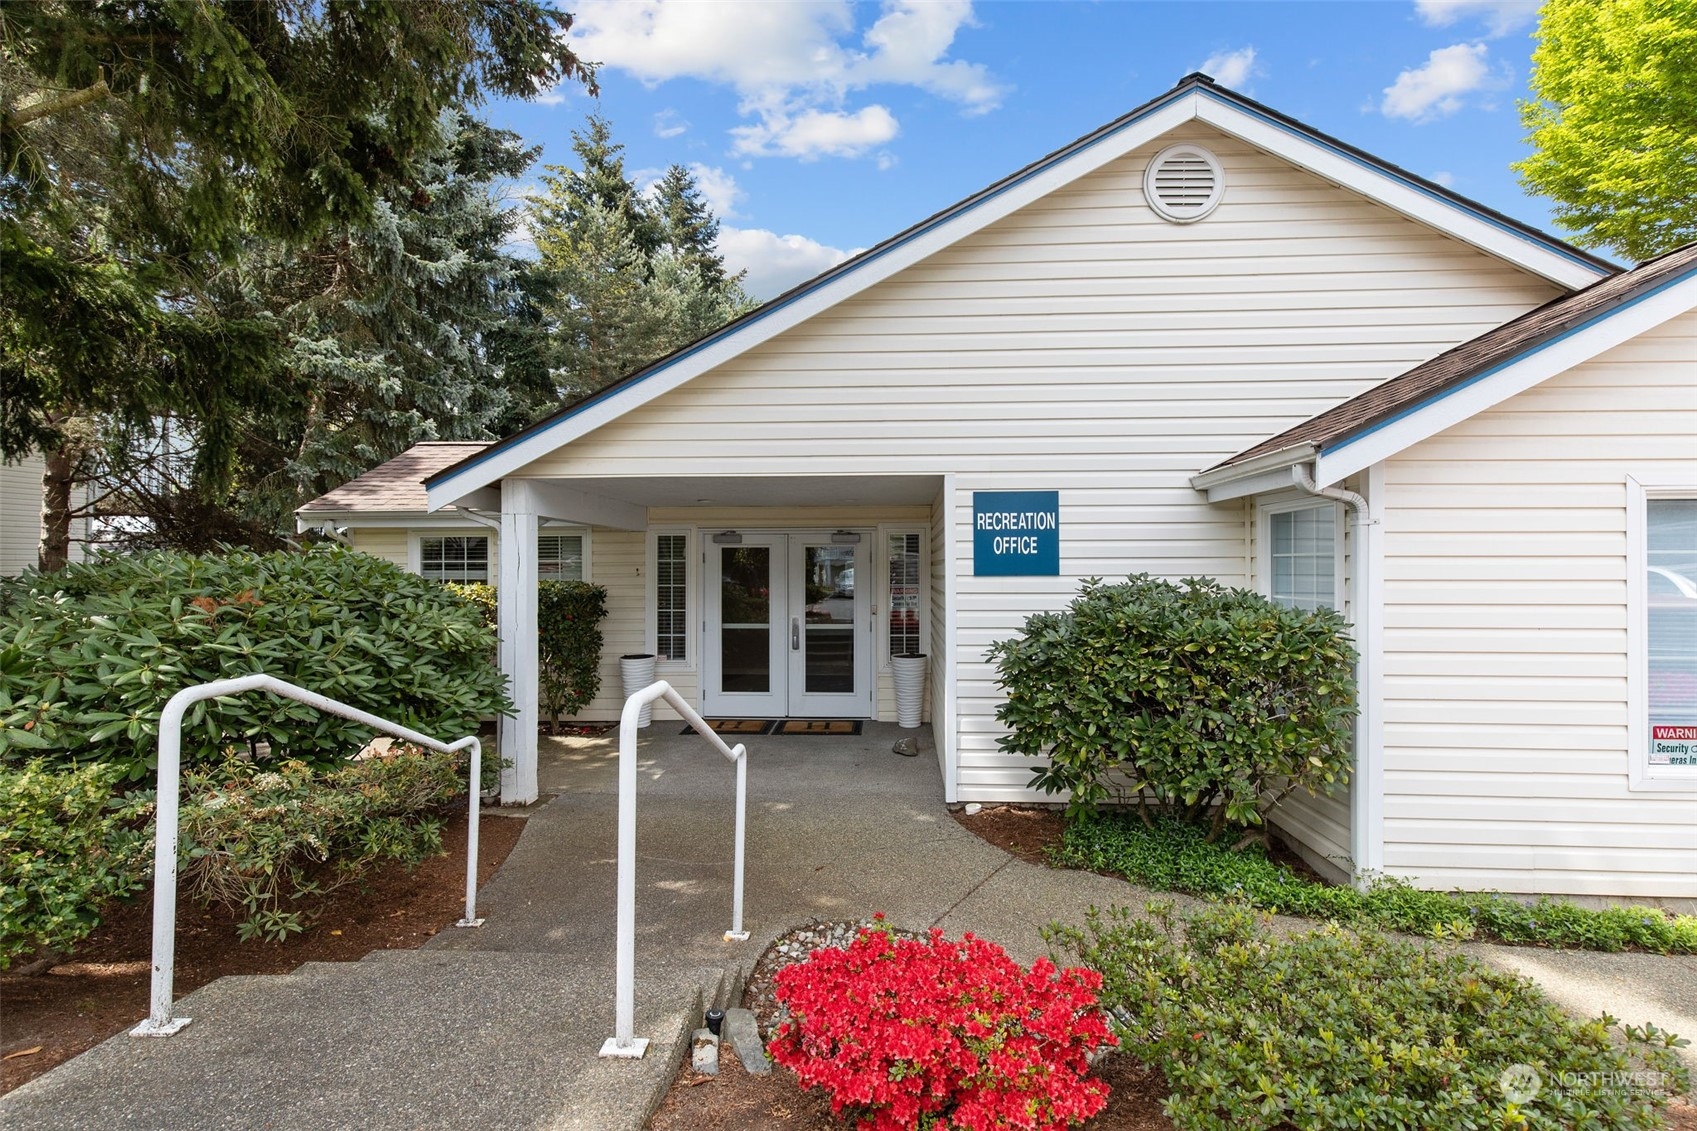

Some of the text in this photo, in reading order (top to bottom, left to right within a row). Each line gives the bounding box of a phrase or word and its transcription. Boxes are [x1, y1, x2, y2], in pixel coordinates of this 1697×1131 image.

[977, 512, 1056, 530] RECREATION
[993, 536, 1038, 554] OFFICE
[1657, 742, 1689, 755] Security
